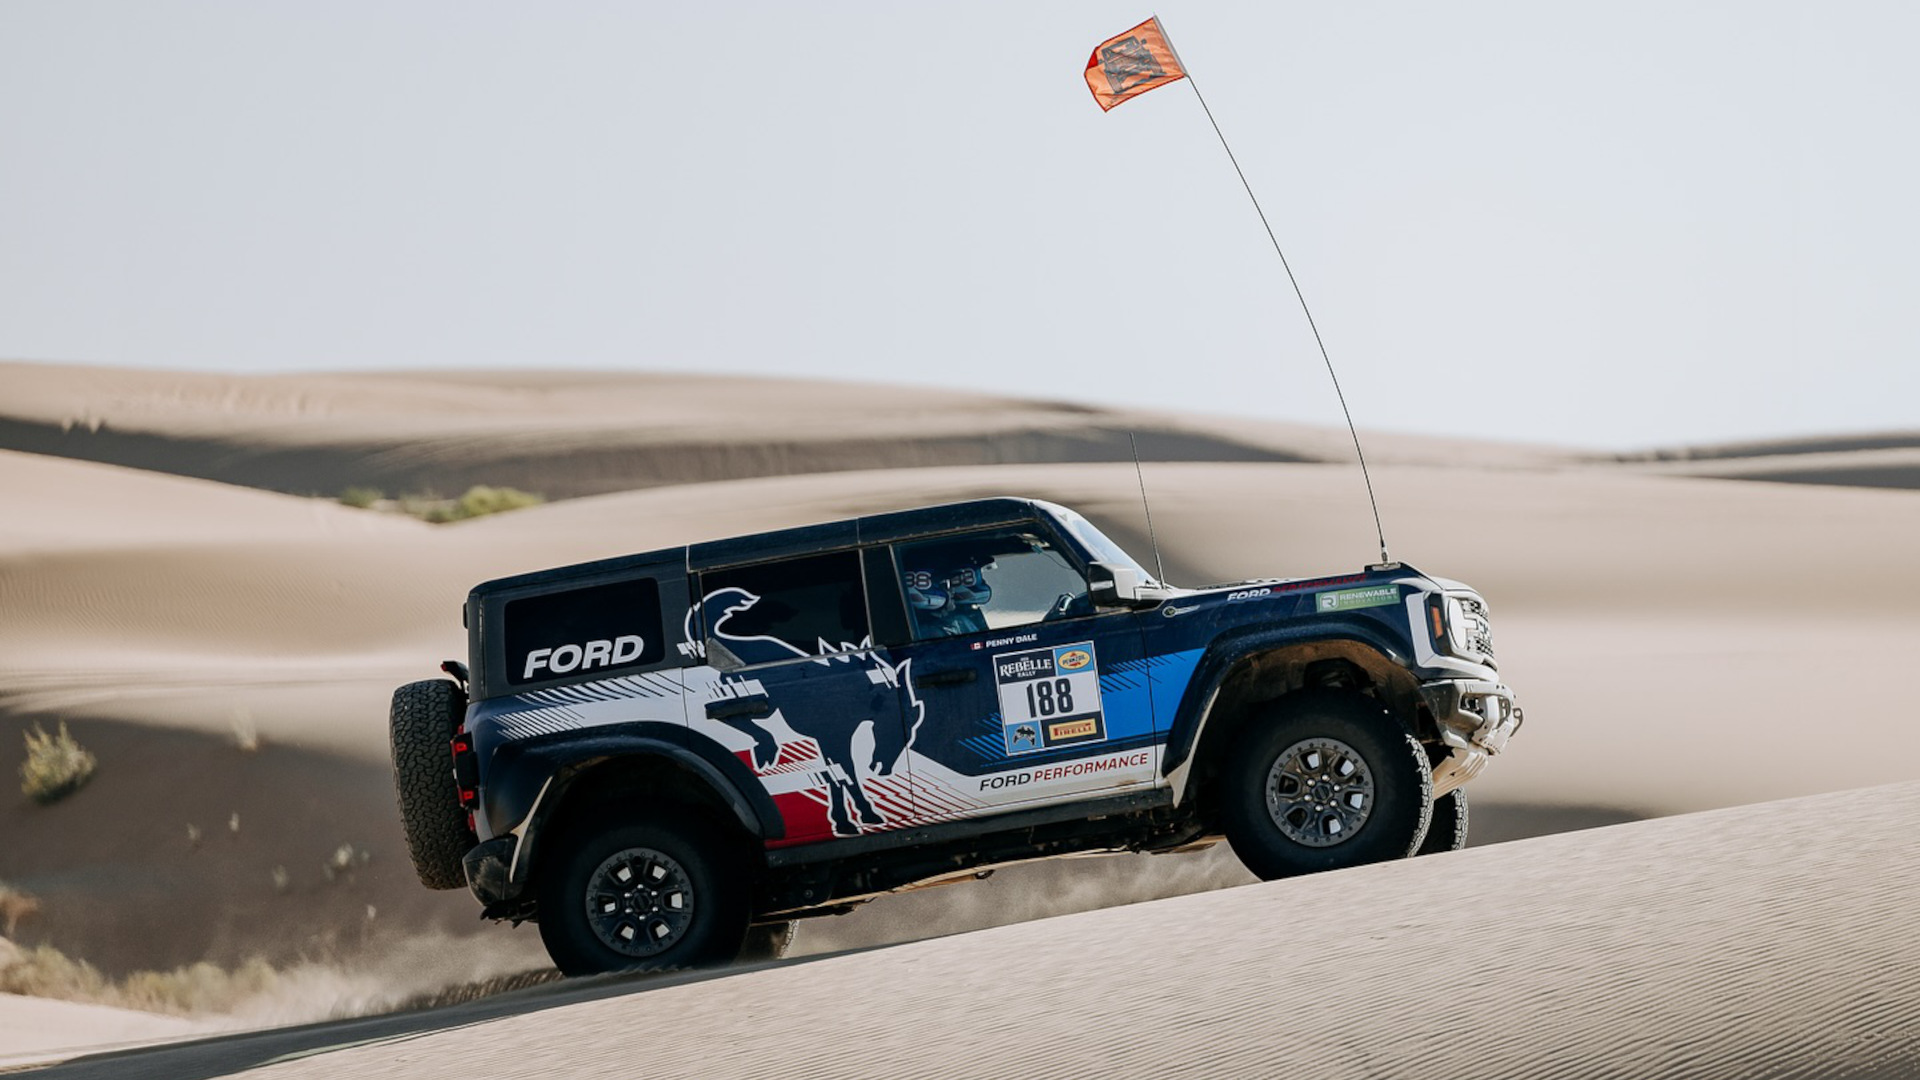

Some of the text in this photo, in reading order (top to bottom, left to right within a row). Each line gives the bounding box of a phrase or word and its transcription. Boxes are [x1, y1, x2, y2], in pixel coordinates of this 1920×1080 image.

[1227, 588, 1271, 602] FORD
[1340, 588, 1397, 601] RENEWABLE
[985, 633, 1038, 648] PENNY DALE
[523, 634, 645, 679] FORD
[999, 658, 1053, 677] REBELLE
[1017, 670, 1036, 678] RALLY
[1026, 678, 1074, 718] 188
[1052, 722, 1092, 737] PIRELLI
[979, 753, 1149, 791] FORD PERFORMANCE
